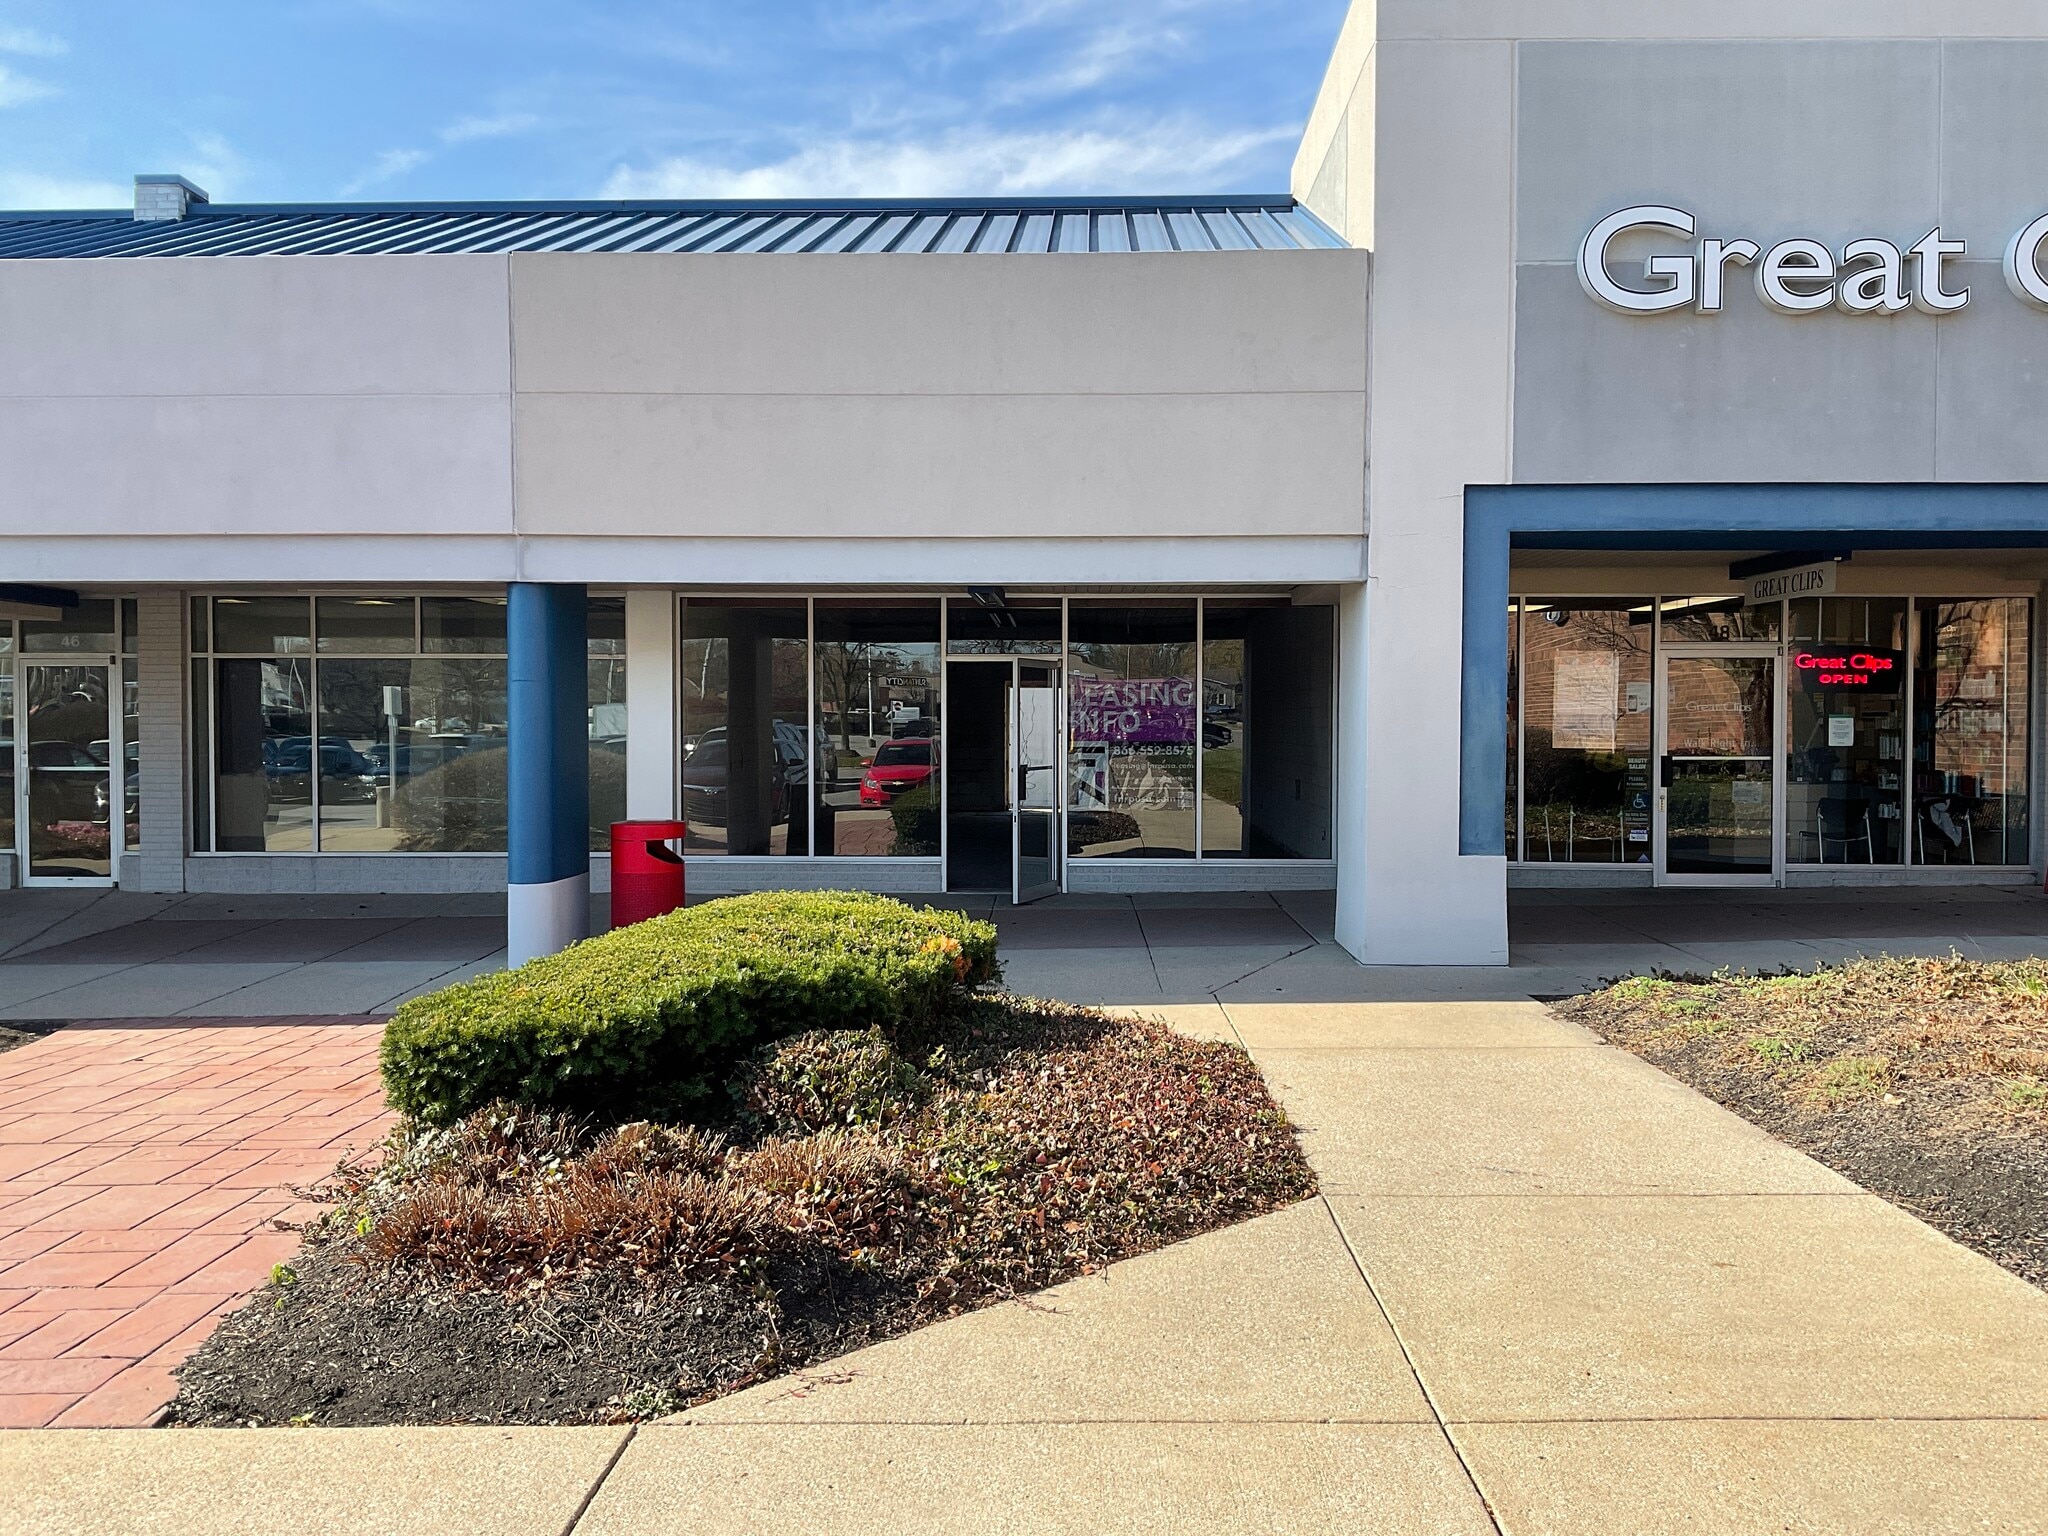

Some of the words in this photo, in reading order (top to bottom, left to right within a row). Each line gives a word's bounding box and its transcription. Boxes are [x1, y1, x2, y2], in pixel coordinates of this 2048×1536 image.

[1578, 204, 1971, 316] Great
[1753, 575, 1790, 599] GREAT
[1791, 568, 1824, 592] CLIPS
[61, 636, 80, 648] 46
[1794, 653, 1847, 670] Great
[1849, 653, 1893, 674] Clips
[1818, 674, 1868, 684] OPEN
[1070, 683, 1194, 707] LEASING
[1685, 701, 1719, 712] Great
[1723, 701, 1752, 714] Clips
[1070, 709, 1141, 734] INFO
[1710, 738, 1736, 750] Right
